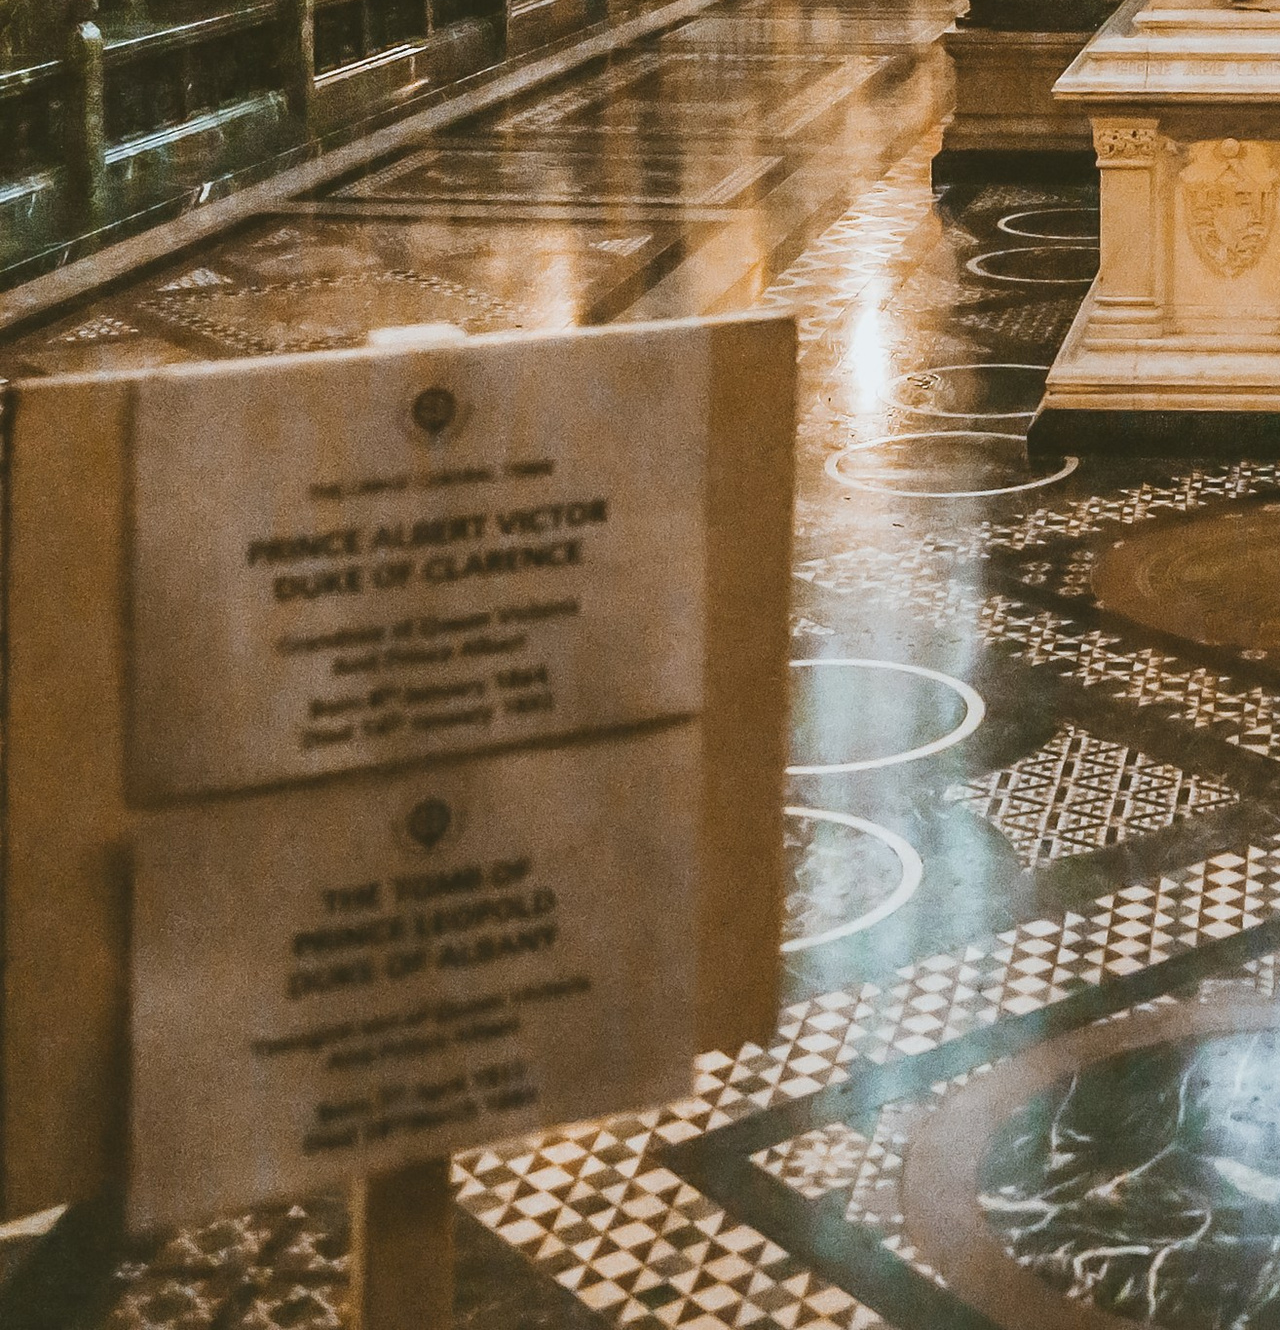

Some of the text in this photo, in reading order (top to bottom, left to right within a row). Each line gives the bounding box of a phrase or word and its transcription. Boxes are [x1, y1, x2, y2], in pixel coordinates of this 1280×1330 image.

[246, 496, 609, 567] PRINCE ALBERT VICTOR
[271, 539, 584, 602] DUKE OF CLARENCE
[321, 880, 381, 914] THE
[412, 886, 559, 939] LEOPOLD
[434, 921, 559, 970] ALBANY
